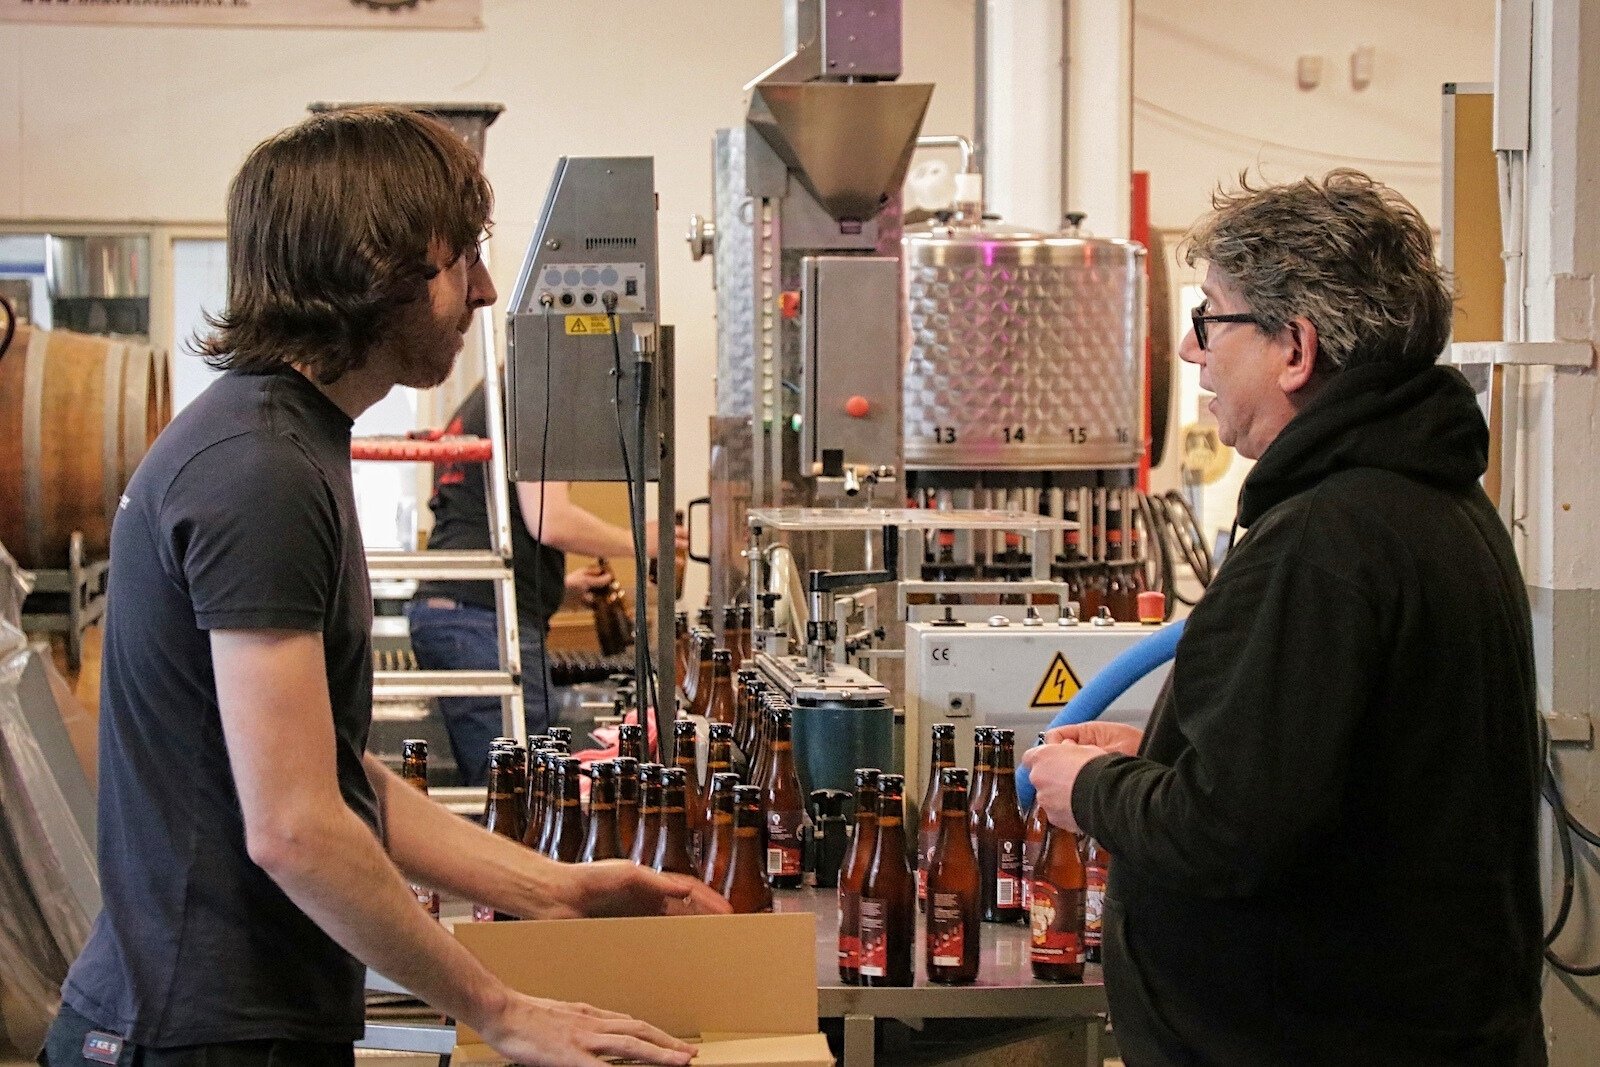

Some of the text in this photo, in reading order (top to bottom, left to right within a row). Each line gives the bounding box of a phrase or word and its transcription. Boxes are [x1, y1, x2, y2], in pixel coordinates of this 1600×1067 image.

[934, 426, 957, 444] 13
[1003, 426, 1025, 444] 14
[1068, 427, 1087, 444] 15
[932, 648, 949, 661] CE
